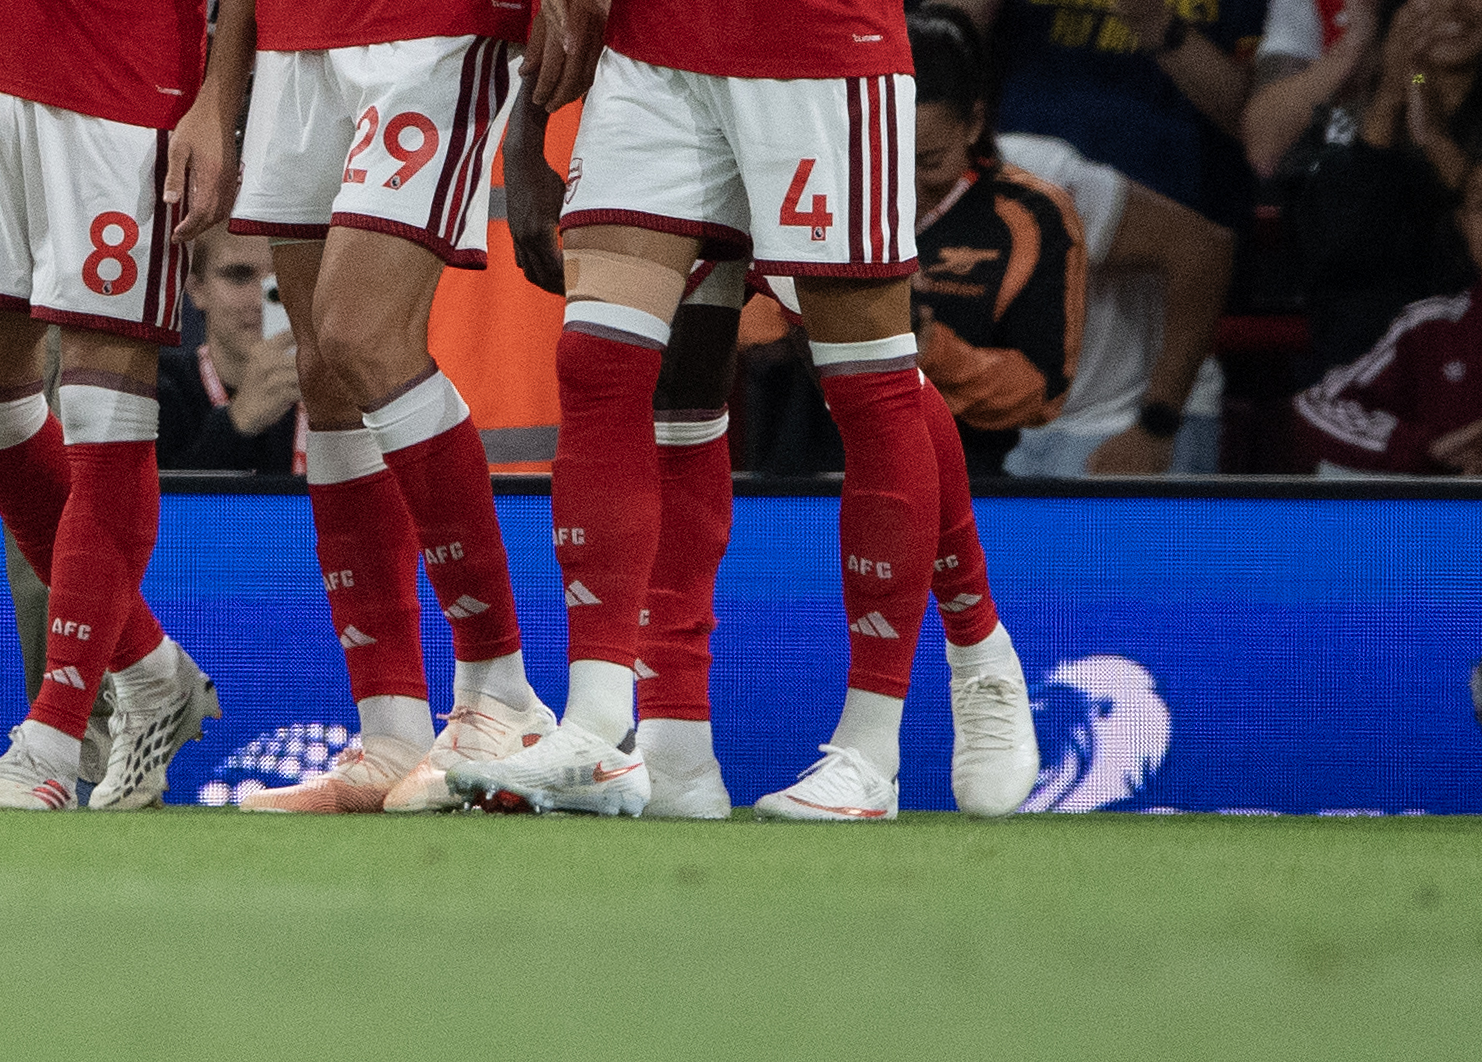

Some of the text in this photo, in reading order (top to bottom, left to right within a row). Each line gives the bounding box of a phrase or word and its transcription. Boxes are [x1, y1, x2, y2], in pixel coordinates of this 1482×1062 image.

[343, 105, 439, 190] 29
[779, 158, 833, 241] 4
[82, 211, 139, 296] 8
[425, 541, 464, 564] AFC
[934, 554, 959, 572] FC
[848, 554, 892, 579] AFC
[52, 618, 92, 640] AFC
